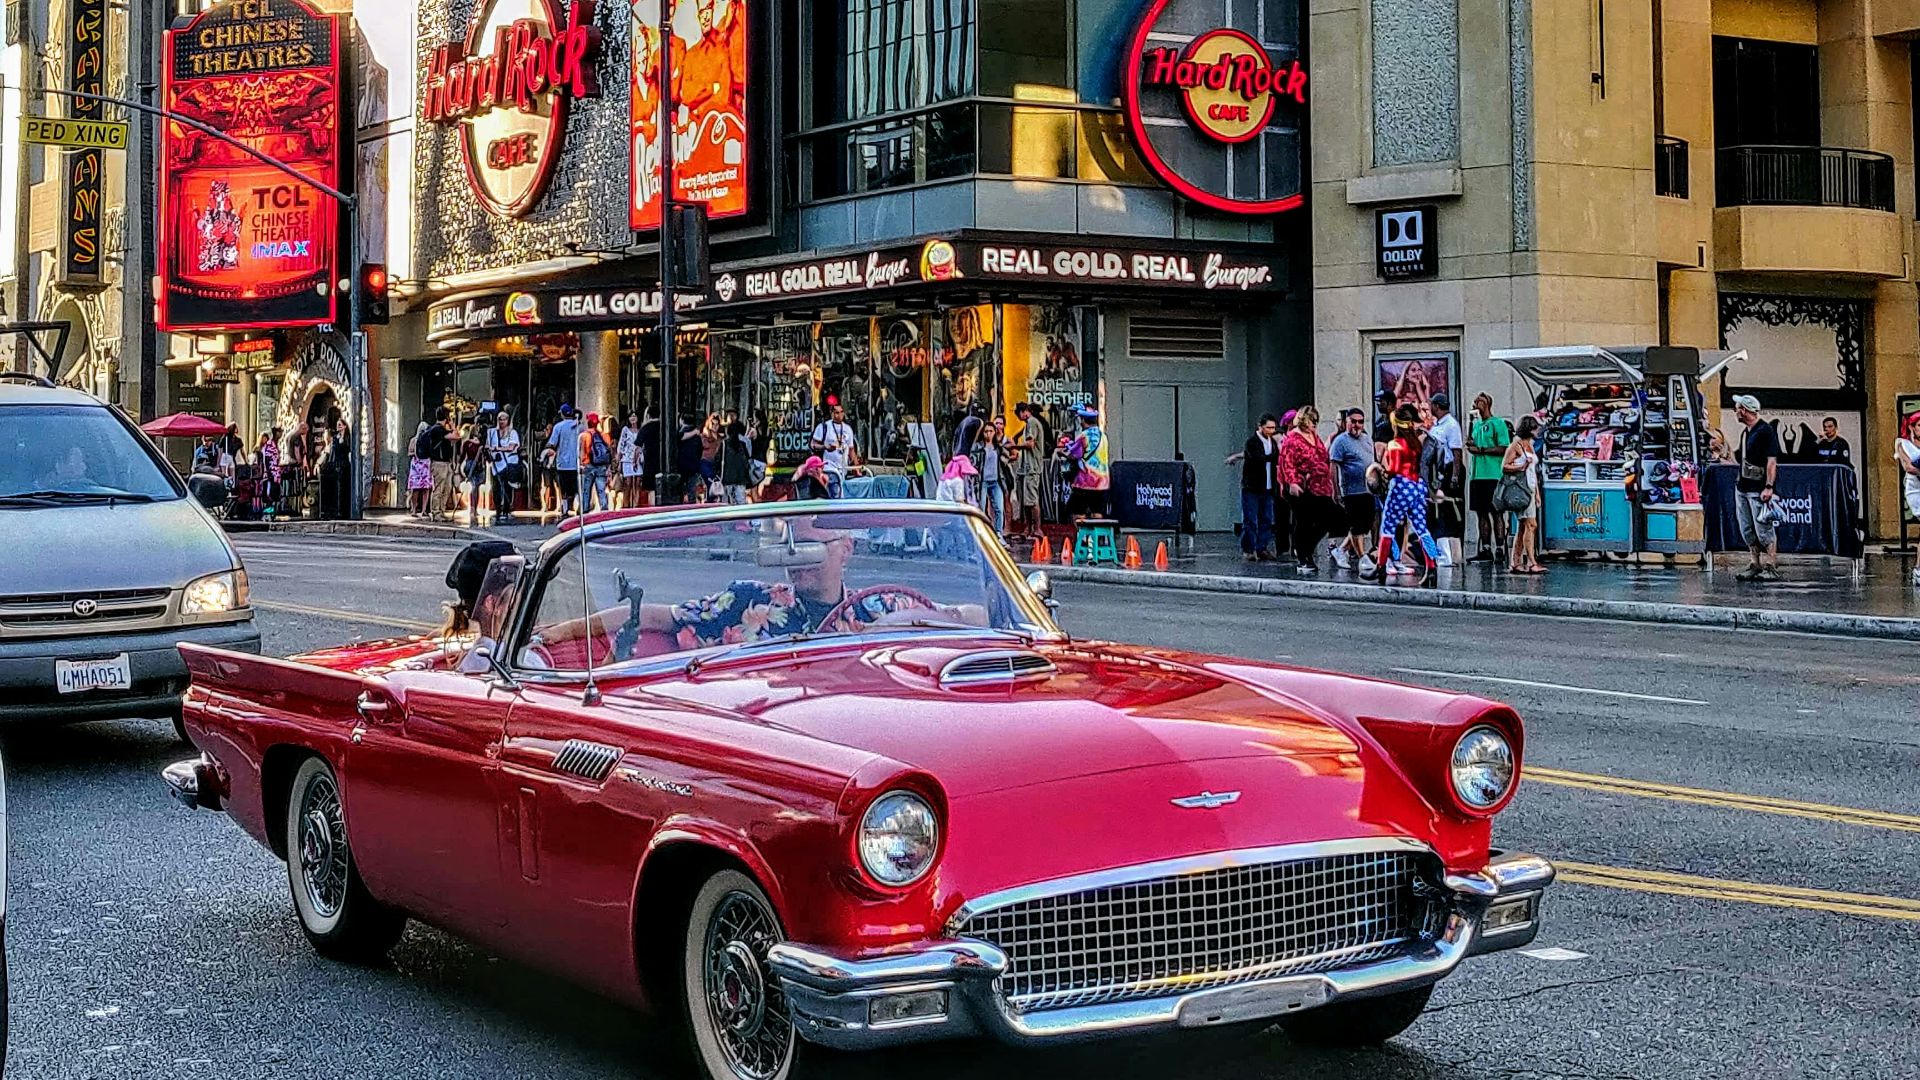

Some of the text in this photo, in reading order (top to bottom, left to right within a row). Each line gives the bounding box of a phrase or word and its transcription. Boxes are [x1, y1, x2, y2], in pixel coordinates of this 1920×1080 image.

[231, 0, 274, 20] TCL
[200, 15, 304, 48] CHINESE
[189, 43, 315, 74] THEATRES
[423, 0, 590, 121] Hard Rock
[1149, 47, 1308, 104] Hard Rock
[1208, 104, 1250, 122] CAFE
[27, 122, 120, 144] PED XING
[487, 133, 535, 169] CAFE
[252, 185, 309, 209] TCL
[252, 211, 309, 228] CHINESE
[252, 225, 309, 242] THEATRE
[251, 240, 311, 258] IMAX
[1383, 249, 1423, 263] DOLBY
[745, 271, 781, 296] REAL
[781, 266, 823, 292] GOLD.
[824, 260, 863, 287] REAL
[866, 252, 910, 289] Burger.
[982, 247, 1273, 290] REAL GOLD. REAL Burger.
[443, 307, 463, 326] REAL
[559, 294, 605, 317] REAL
[318, 323, 334, 332] TCL
[1026, 378, 1064, 391] COME
[1027, 392, 1093, 405] TOGETHER
[63, 667, 126, 689] 4MHA051
